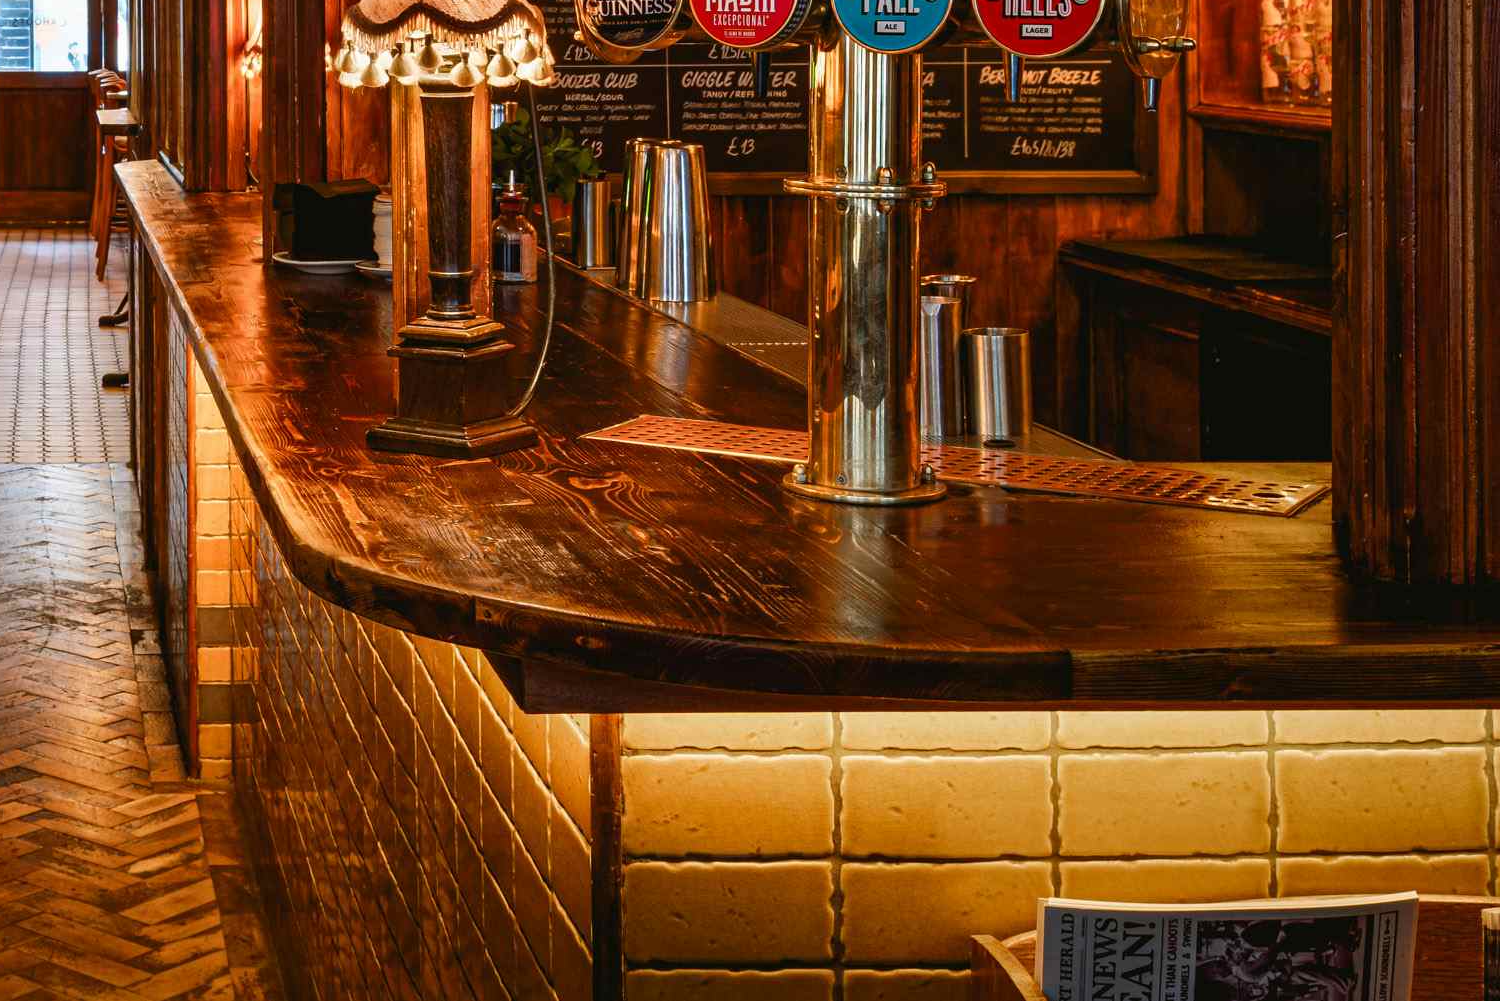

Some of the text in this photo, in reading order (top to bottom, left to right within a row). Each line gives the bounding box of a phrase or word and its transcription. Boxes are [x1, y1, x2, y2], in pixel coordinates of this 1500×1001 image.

[713, 14, 767, 26] EXCEPCIONAL
[550, 72, 638, 88] BOOZER CLUB
[682, 71, 735, 88] GIGGLE
[1048, 67, 1102, 85] BREEZE
[1060, 912, 1075, 981] HERALD
[1167, 917, 1179, 961] CAHOOTS
[1091, 917, 1118, 1001] NEWS
